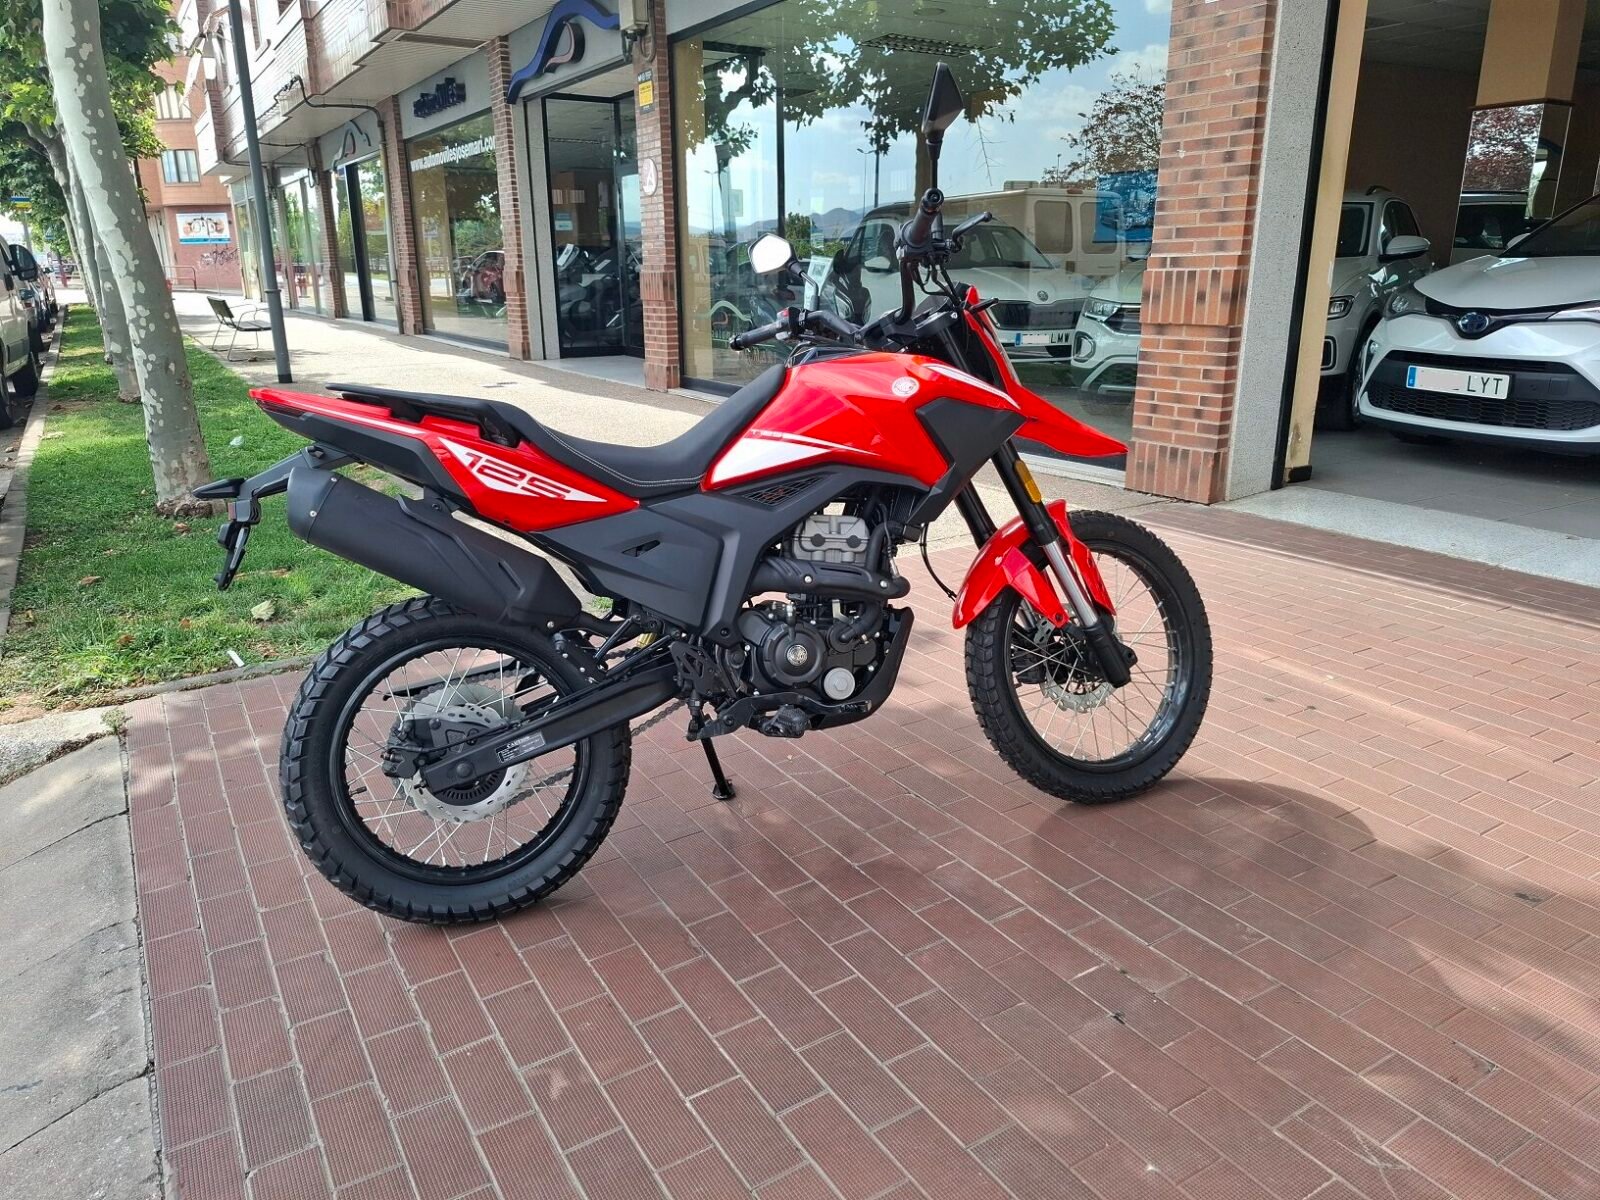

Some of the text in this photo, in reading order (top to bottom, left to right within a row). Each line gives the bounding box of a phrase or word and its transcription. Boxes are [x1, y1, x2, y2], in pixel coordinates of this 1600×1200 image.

[1050, 332, 1070, 344] LMW
[1466, 375, 1504, 395] LYT
[465, 451, 572, 499] 125
